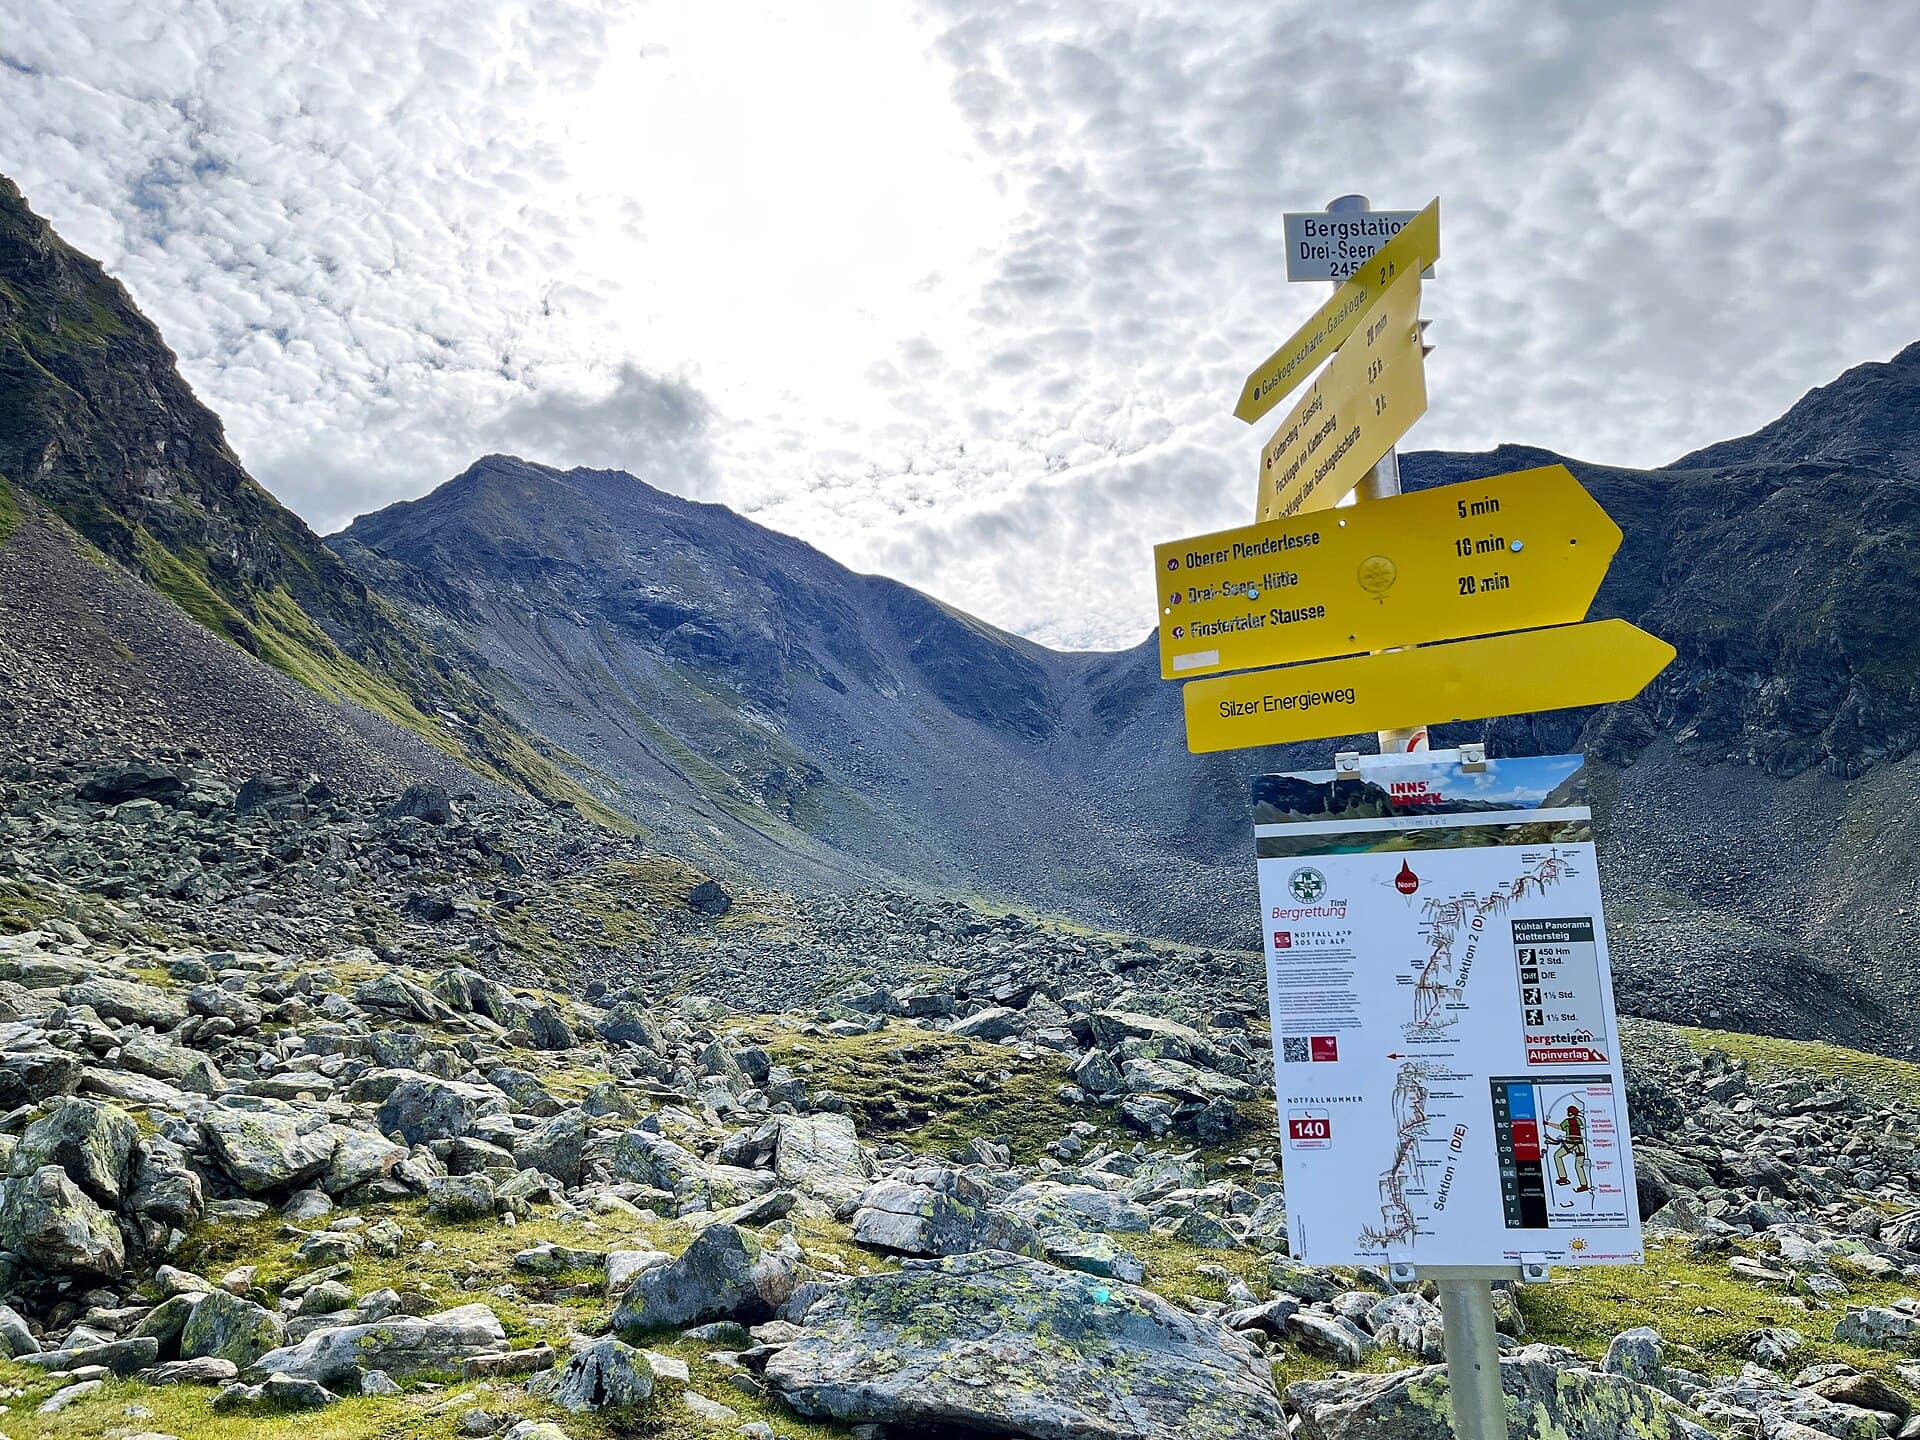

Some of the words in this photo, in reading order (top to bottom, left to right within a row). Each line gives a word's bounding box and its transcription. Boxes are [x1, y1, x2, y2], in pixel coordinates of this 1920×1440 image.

[1380, 267, 1386, 286] 2
[1389, 261, 1394, 277] h
[1375, 313, 1387, 338] min
[1378, 356, 1383, 374] h
[1185, 549, 1230, 569] Oberer
[1233, 531, 1320, 560] Plenderlesee
[1457, 500, 1467, 518] 5
[1470, 495, 1500, 517] min
[1475, 533, 1505, 554] min
[1190, 613, 1266, 638] Finstertaler
[1270, 605, 1325, 626] Stausee
[1458, 575, 1476, 596] 20
[1480, 572, 1510, 592] min
[1219, 699, 1260, 718] Silzer
[1263, 687, 1355, 712] Energieweg
[1397, 881, 1417, 889] Nord
[1330, 899, 1347, 907] Tirol
[1271, 906, 1346, 921] Bergrettung
[1471, 914, 1487, 932] (D)
[1514, 922, 1543, 931] Kühtai
[1545, 921, 1590, 929] Panorama
[1468, 934, 1479, 942] 2
[1515, 932, 1570, 941] Klettersteig
[1455, 944, 1475, 988] Sektion
[1547, 957, 1564, 965] Std.
[1541, 971, 1557, 979] D/E
[1558, 991, 1576, 999] Std.
[1560, 1013, 1579, 1021] Std.
[1530, 1050, 1589, 1061] Alpinverlag
[1287, 1096, 1363, 1104] NOTFALLNUMMER
[1295, 1122, 1325, 1137] 140
[1433, 1166, 1456, 1211] Sektion
[1449, 1123, 1469, 1153] (D/E)
